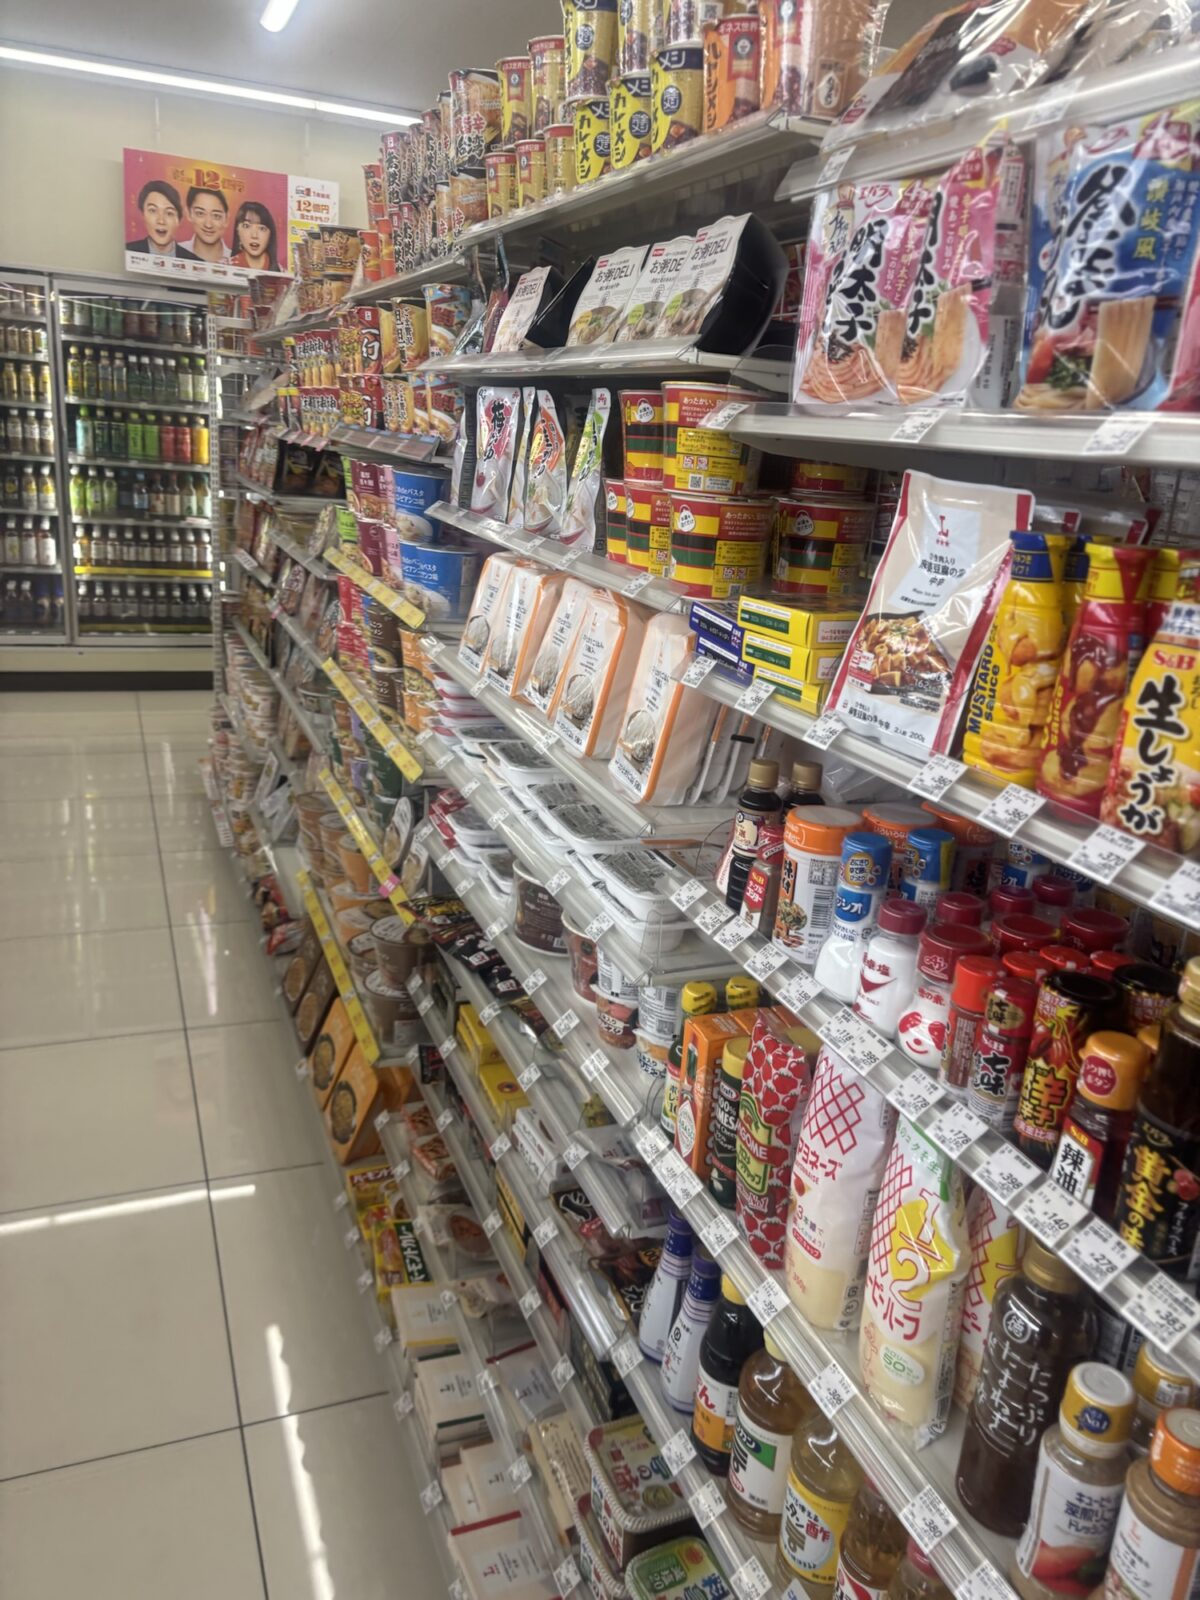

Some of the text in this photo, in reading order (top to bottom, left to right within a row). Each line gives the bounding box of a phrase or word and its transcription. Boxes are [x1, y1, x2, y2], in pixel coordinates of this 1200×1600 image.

[579, 114, 592, 180] カレーメシ
[614, 93, 627, 164] カレーメシ
[595, 263, 636, 285] お粥DELI
[967, 645, 995, 736] MUSTARD
[1153, 648, 1197, 672] S&B
[1119, 674, 1186, 834] 生しょうが
[1055, 1143, 1087, 1199] 辣油
